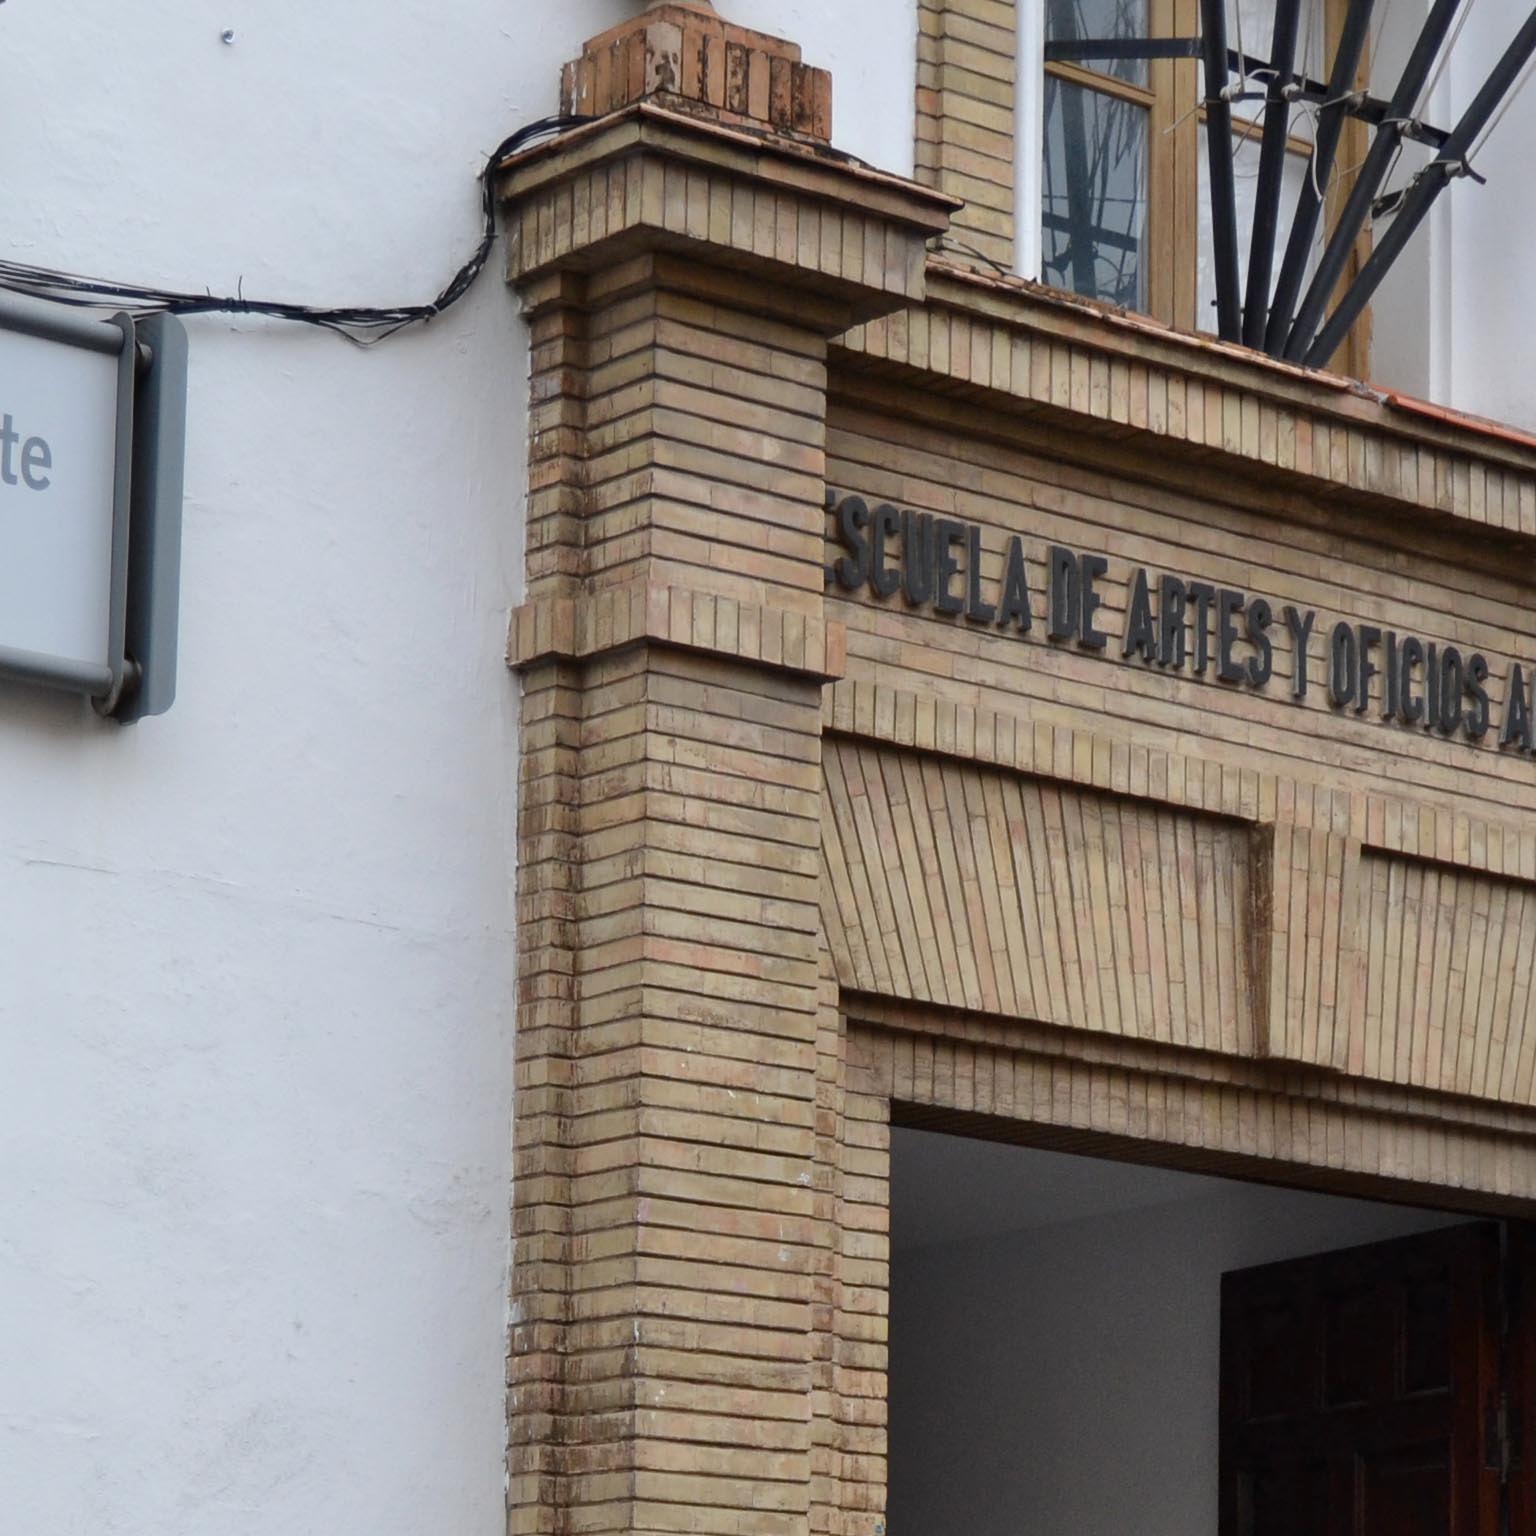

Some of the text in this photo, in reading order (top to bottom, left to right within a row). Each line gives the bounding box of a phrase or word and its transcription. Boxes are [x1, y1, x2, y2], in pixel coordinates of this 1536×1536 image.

[1046, 544, 1109, 650] DE
[1122, 566, 1275, 688] ARTES
[1283, 605, 1316, 699] Y
[1326, 619, 1491, 740] OFICIOS
